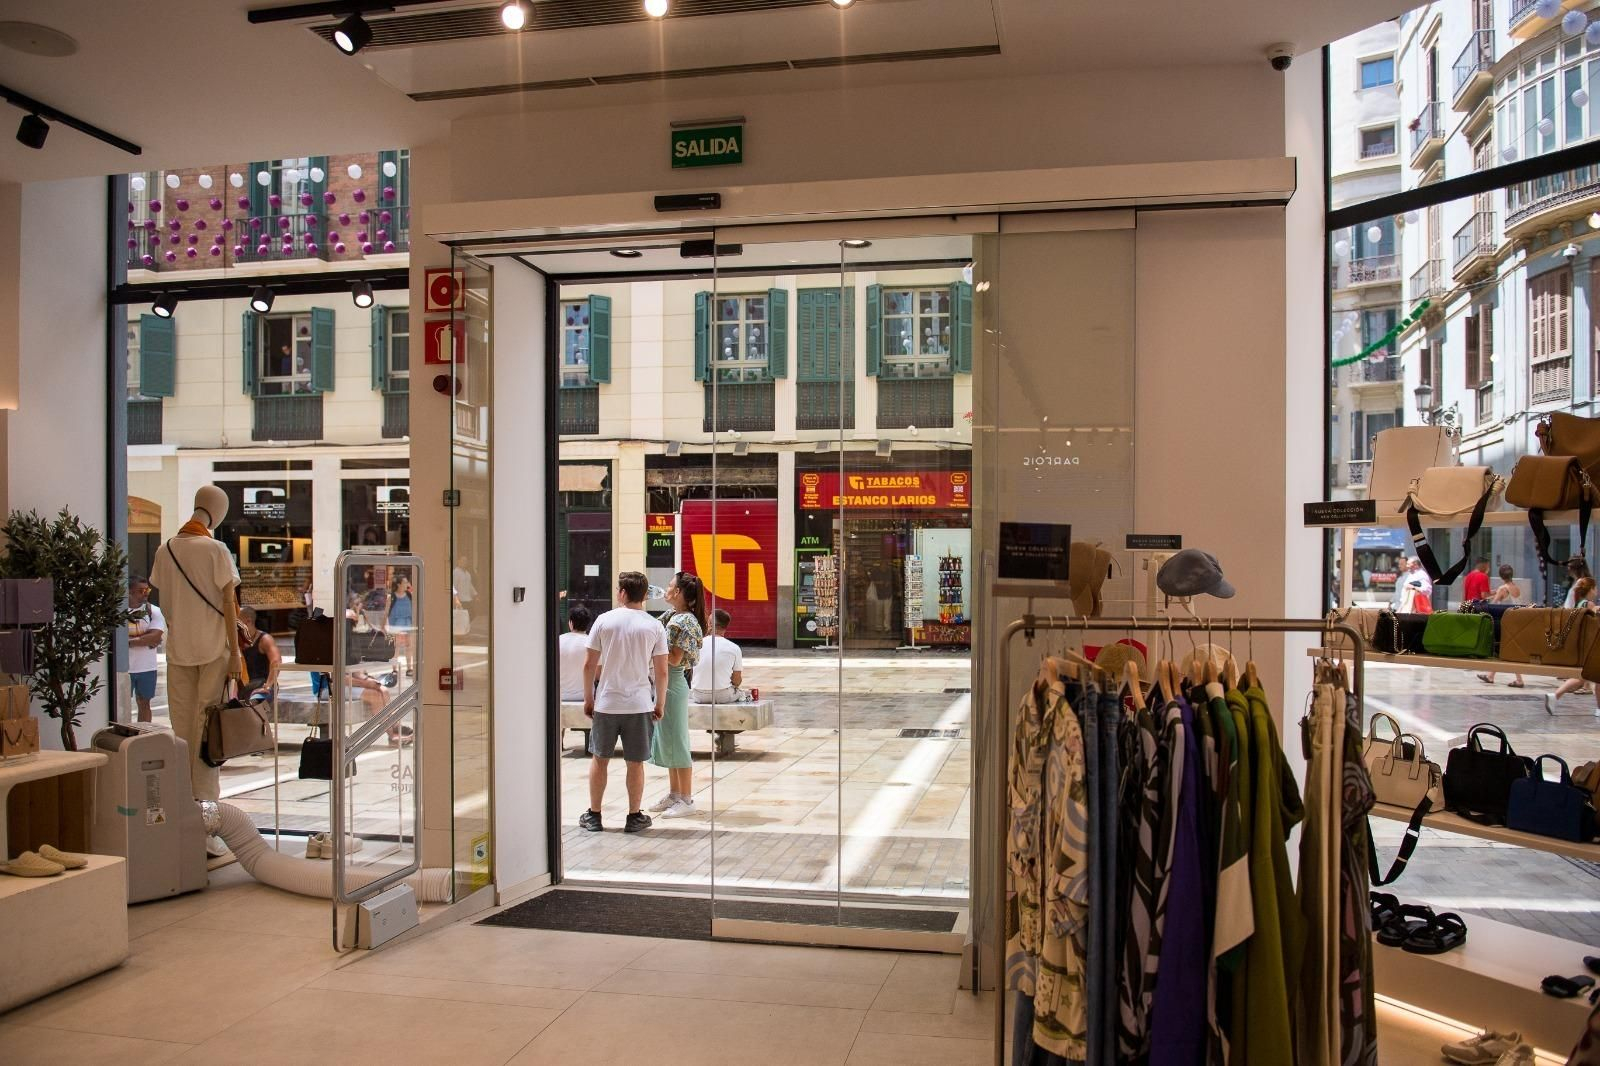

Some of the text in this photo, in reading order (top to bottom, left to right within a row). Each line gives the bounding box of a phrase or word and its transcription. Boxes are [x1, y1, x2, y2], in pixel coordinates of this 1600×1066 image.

[675, 136, 739, 157] SALIDA
[866, 477, 920, 486] TABACOS
[832, 495, 888, 505] ESTANCO
[891, 495, 937, 505] LARIOS
[652, 539, 671, 547] ATM
[800, 536, 820, 545] ATM
